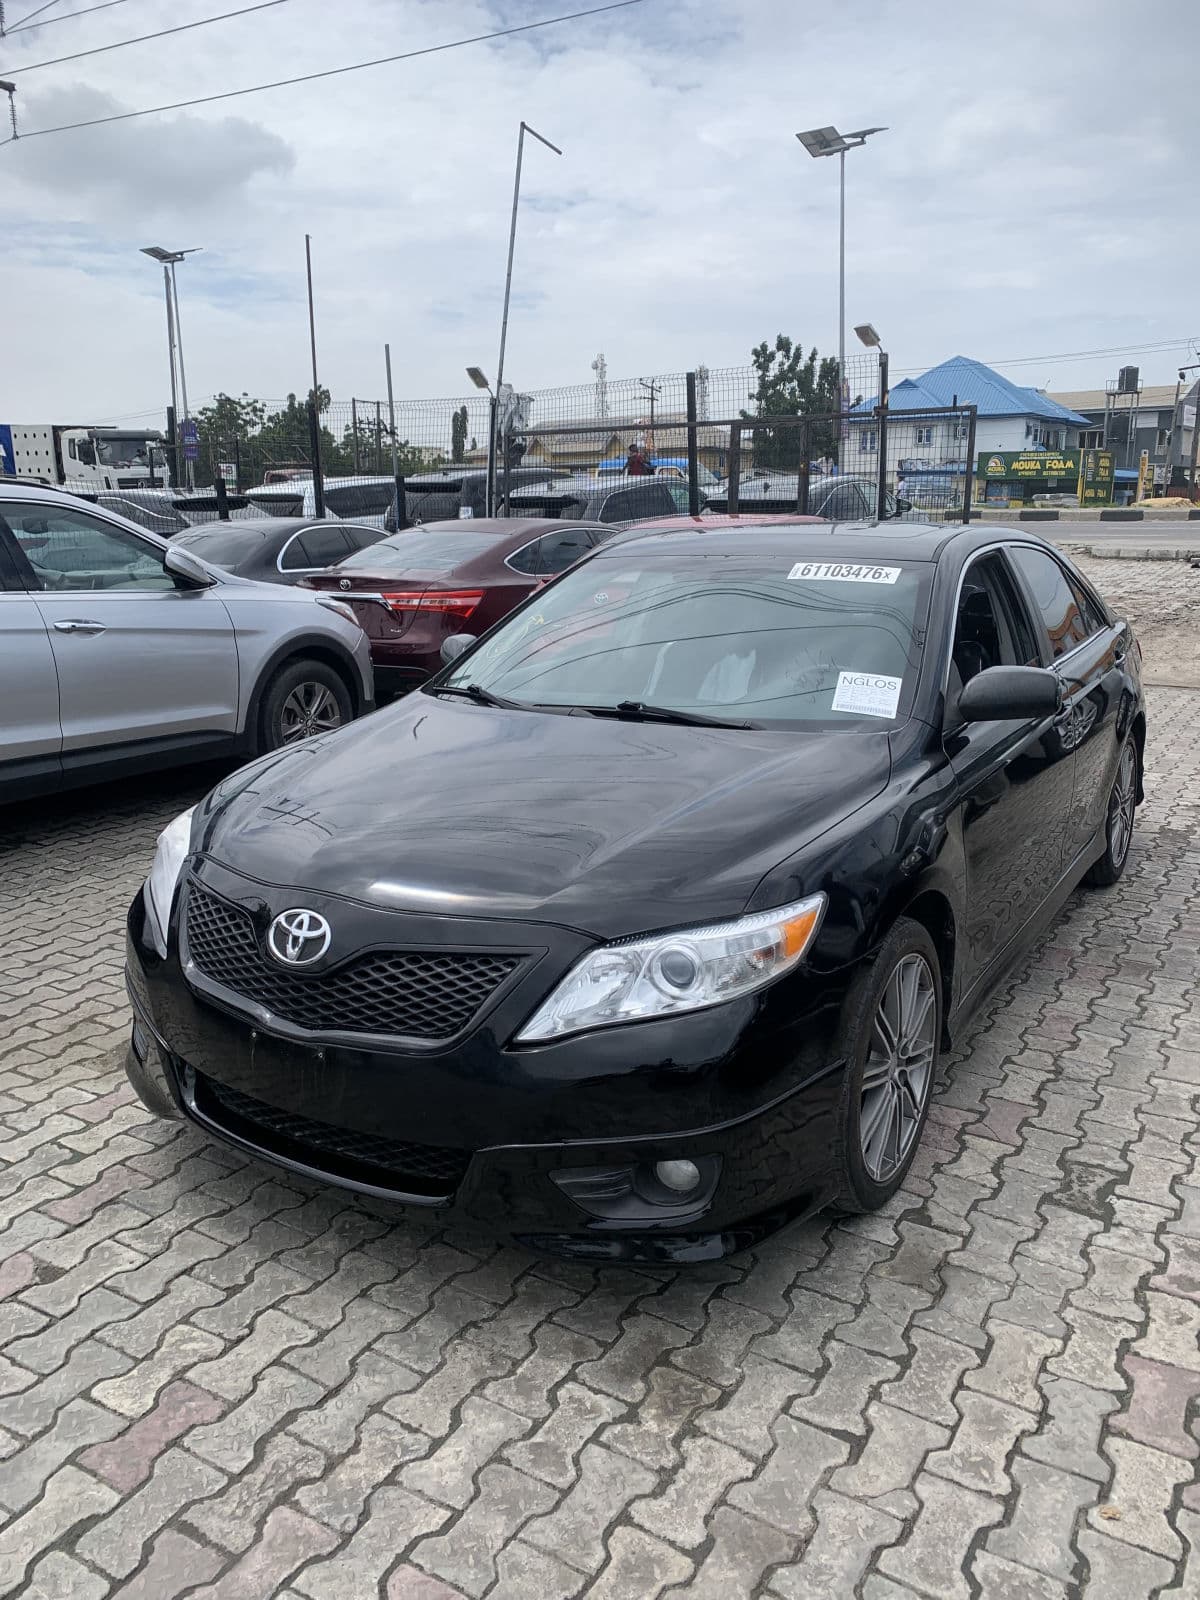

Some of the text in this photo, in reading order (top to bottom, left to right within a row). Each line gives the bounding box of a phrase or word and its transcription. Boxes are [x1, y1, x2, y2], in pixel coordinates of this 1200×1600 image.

[1011, 459, 1074, 470] MOUKA FOAM
[842, 676, 897, 691] NGLOS
